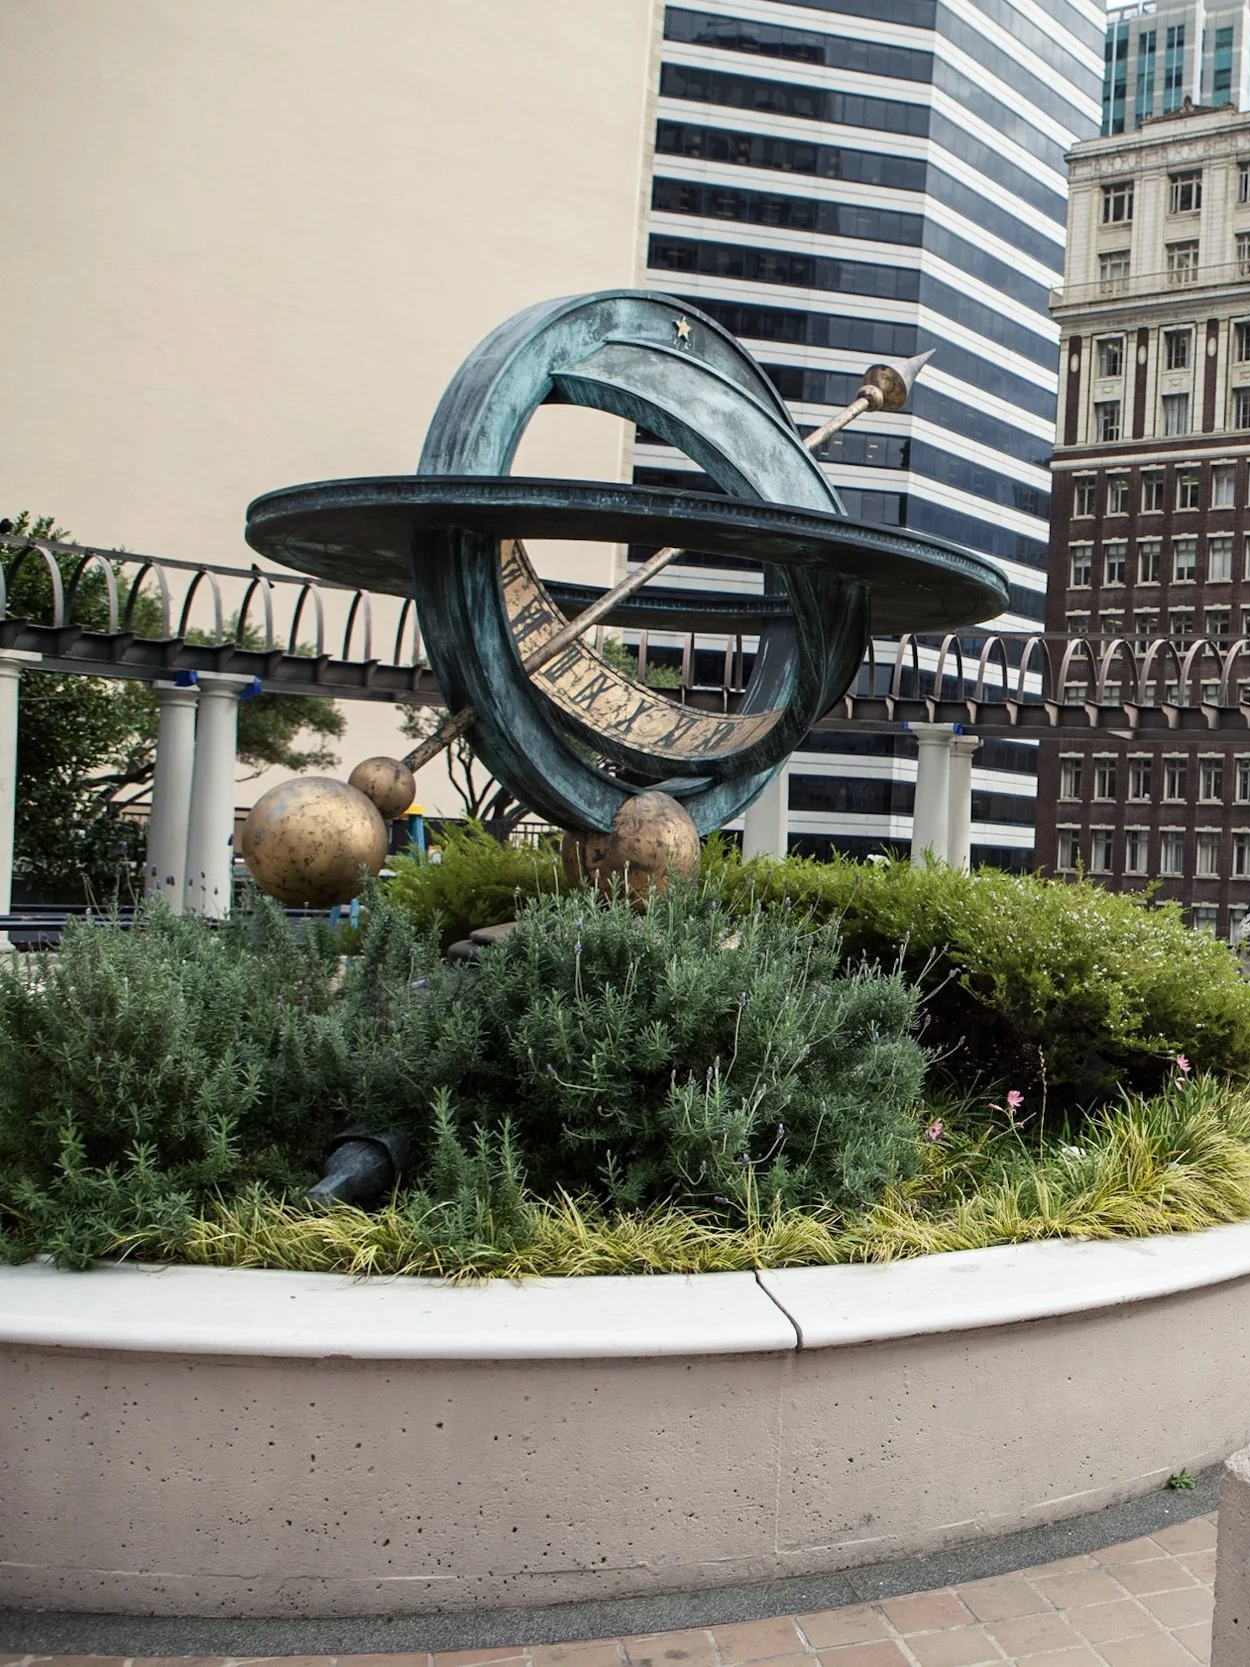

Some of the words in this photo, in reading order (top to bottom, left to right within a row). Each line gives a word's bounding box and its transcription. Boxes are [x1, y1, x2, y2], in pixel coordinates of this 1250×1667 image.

[568, 667, 619, 713] IX
[603, 697, 659, 735] X
[653, 709, 702, 750] XI
